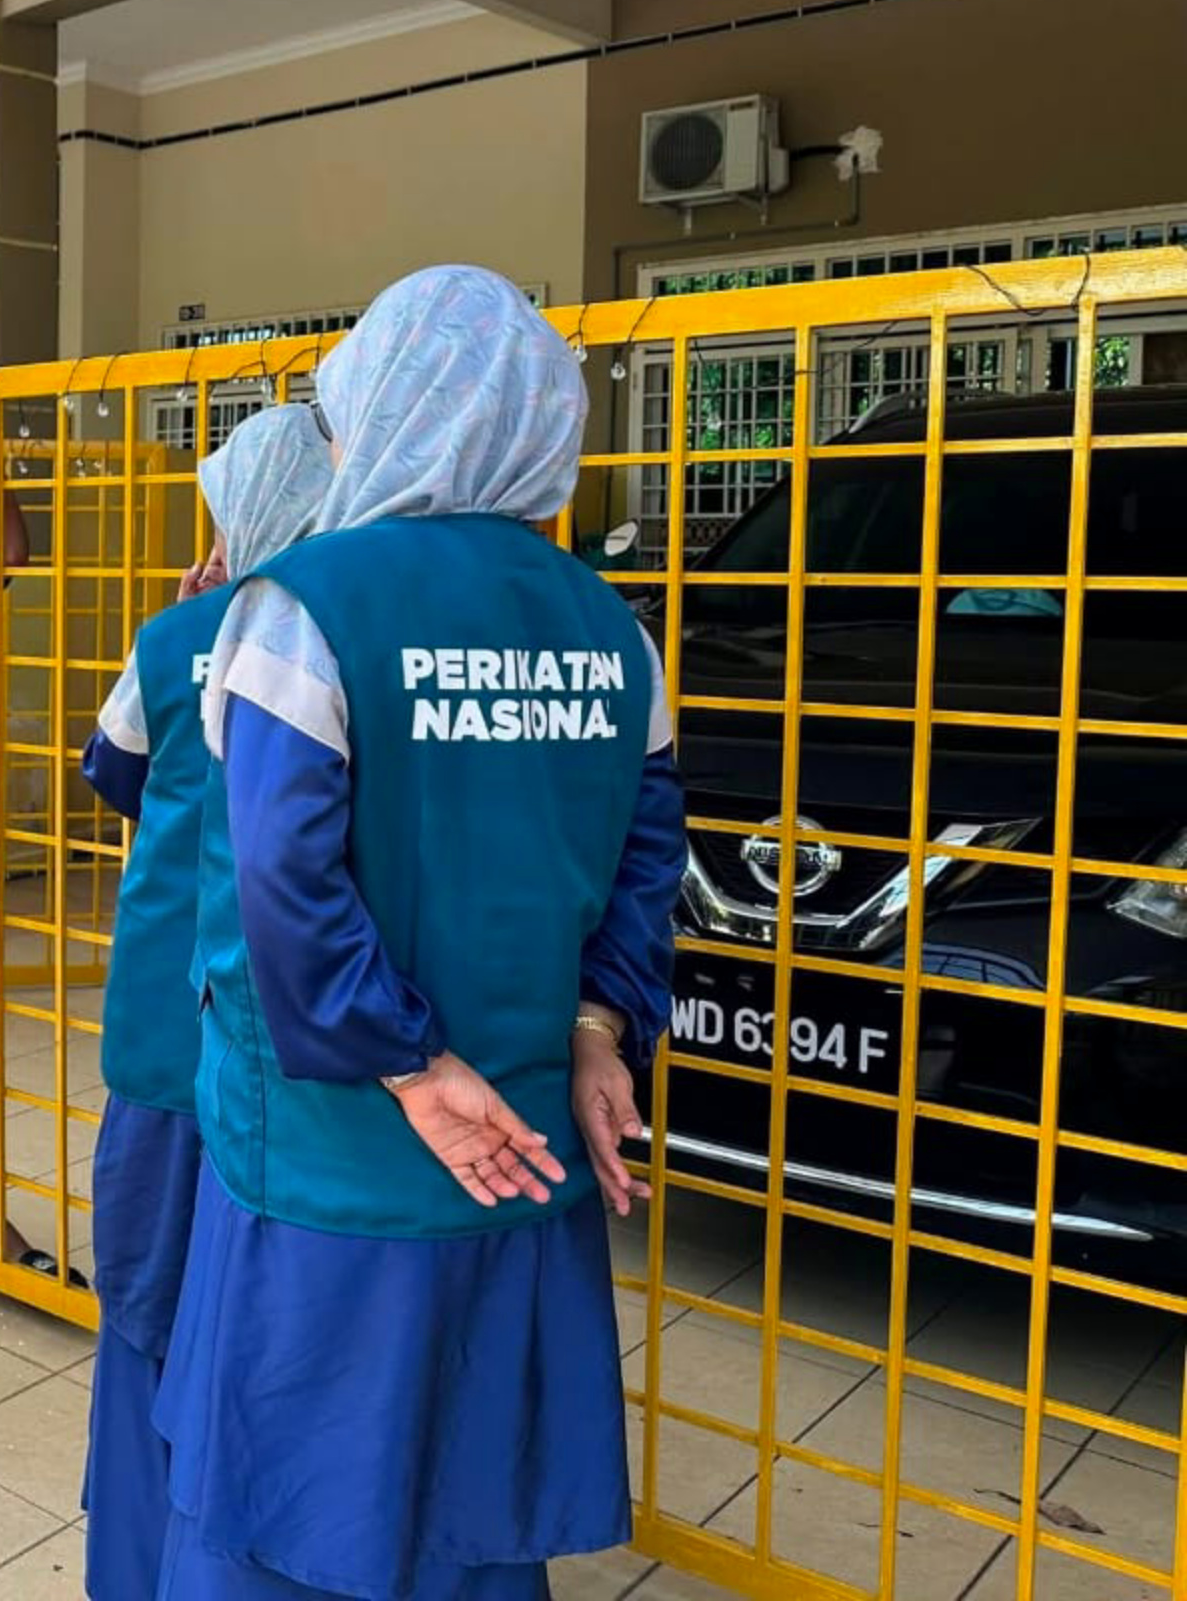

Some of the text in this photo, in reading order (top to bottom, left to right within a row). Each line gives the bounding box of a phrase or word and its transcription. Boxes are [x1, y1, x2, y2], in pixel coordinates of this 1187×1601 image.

[401, 648, 624, 691] PERIKATAN
[671, 994, 724, 1045] WD
[858, 1027, 889, 1074] F
